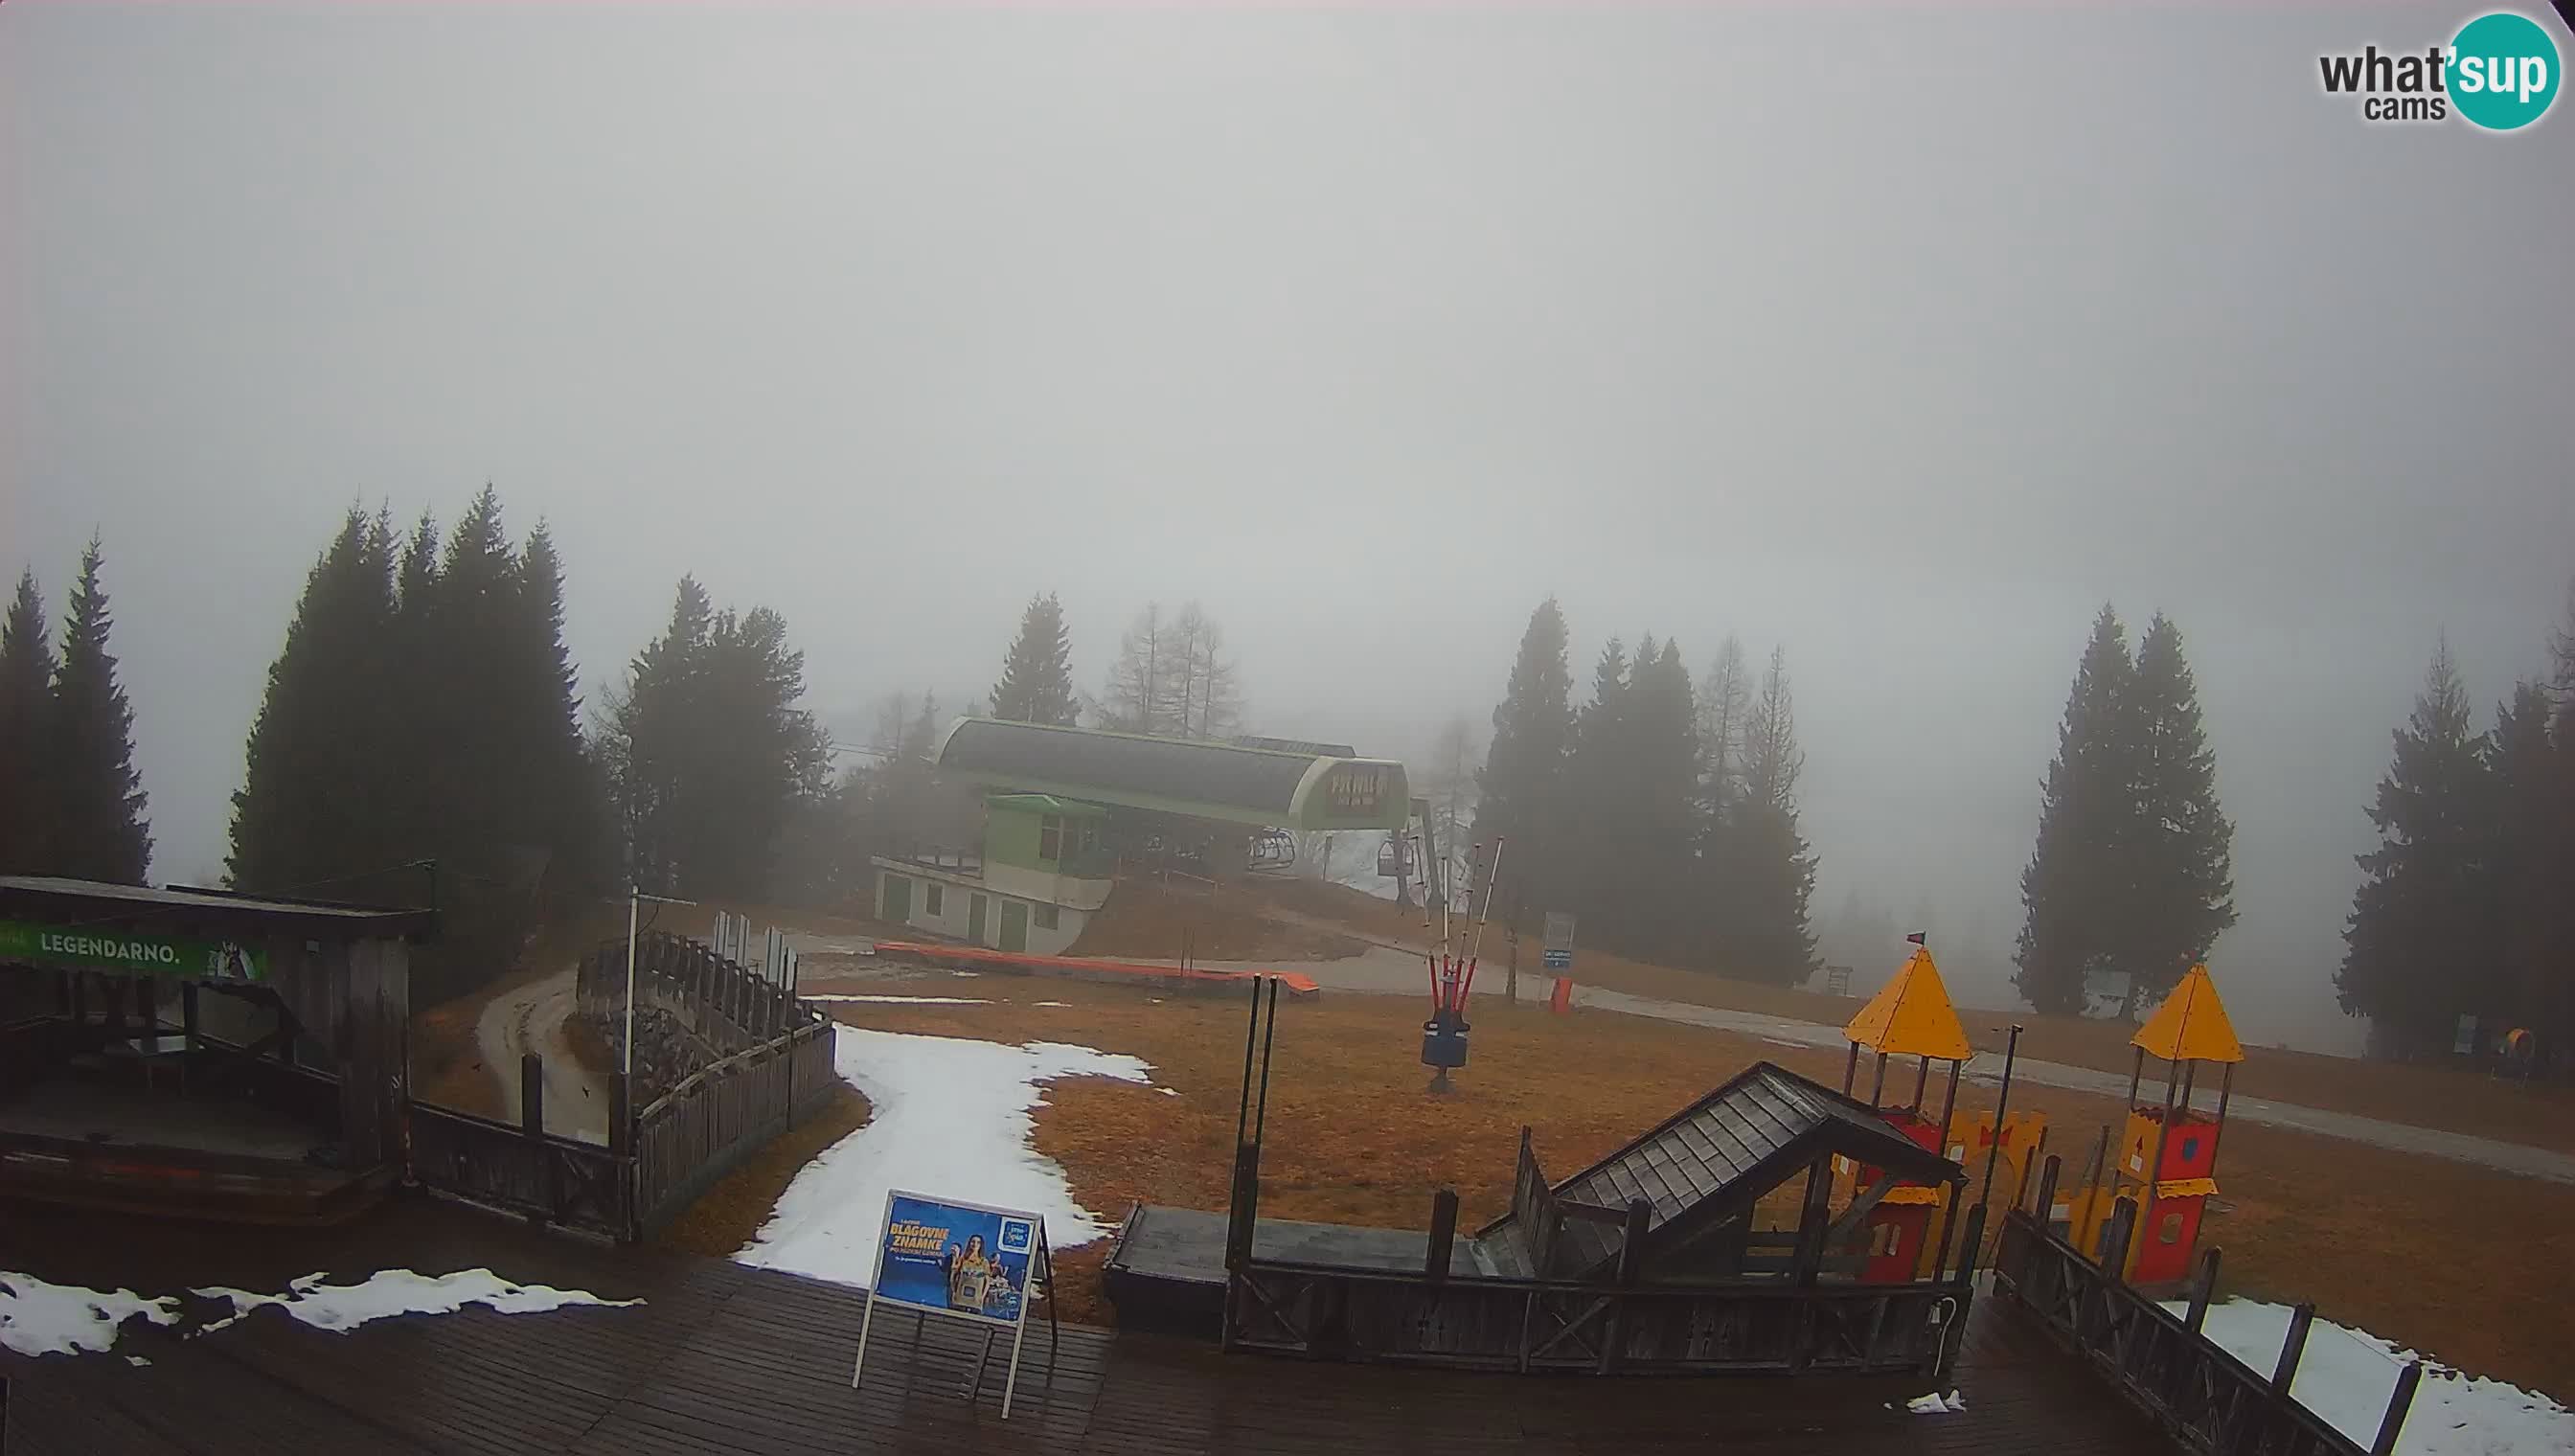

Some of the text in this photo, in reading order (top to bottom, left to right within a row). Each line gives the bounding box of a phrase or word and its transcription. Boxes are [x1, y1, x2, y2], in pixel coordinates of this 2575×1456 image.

[41, 933, 180, 964] LEGENDARNO.
[891, 1223, 949, 1240] BLAGOVNE
[893, 1236, 943, 1250] ZNAMKE
